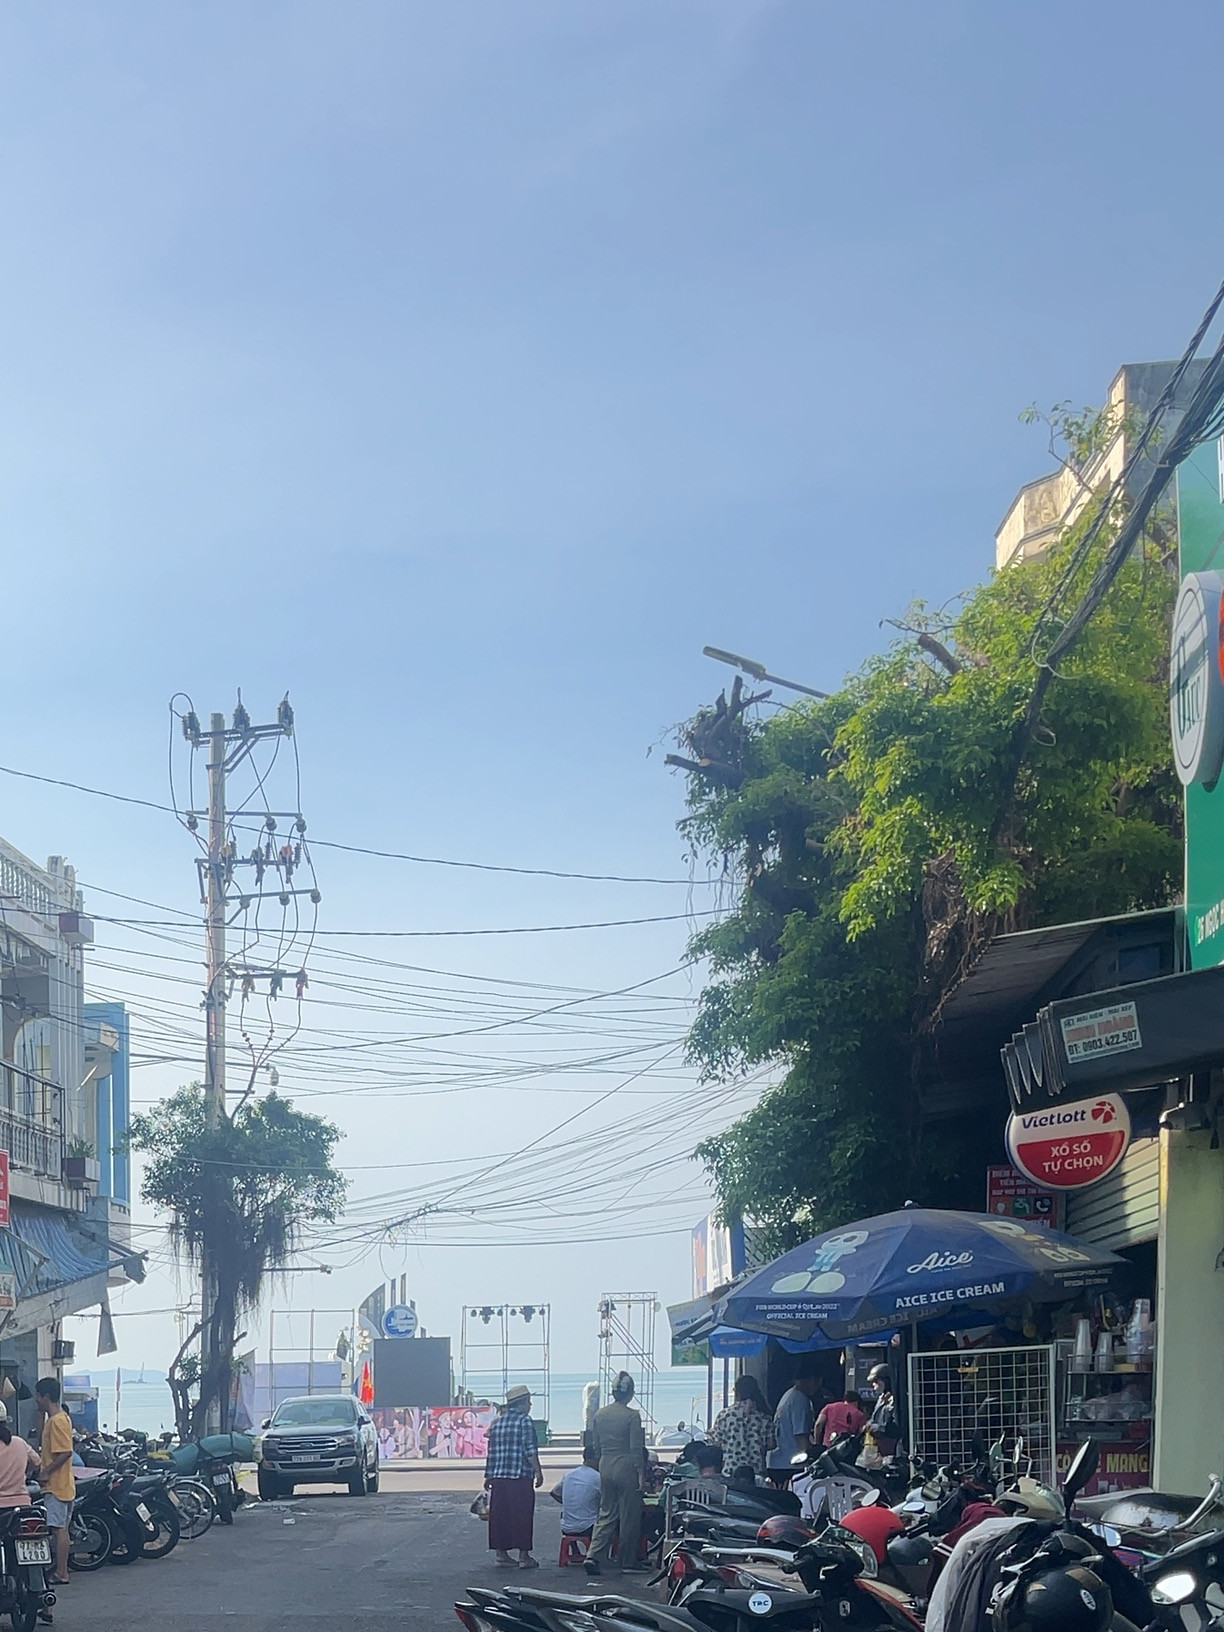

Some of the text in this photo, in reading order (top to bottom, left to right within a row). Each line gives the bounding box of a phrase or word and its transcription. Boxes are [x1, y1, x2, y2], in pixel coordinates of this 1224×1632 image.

[1022, 1108, 1087, 1129] Vietlott
[1072, 1139, 1091, 1154] SỐ
[1043, 1155, 1103, 1175] TỰ CHỌN
[906, 1250, 973, 1274] Aice
[895, 1282, 1005, 1308] AICE ICE CREAM
[1106, 1453, 1151, 1473] MANG
